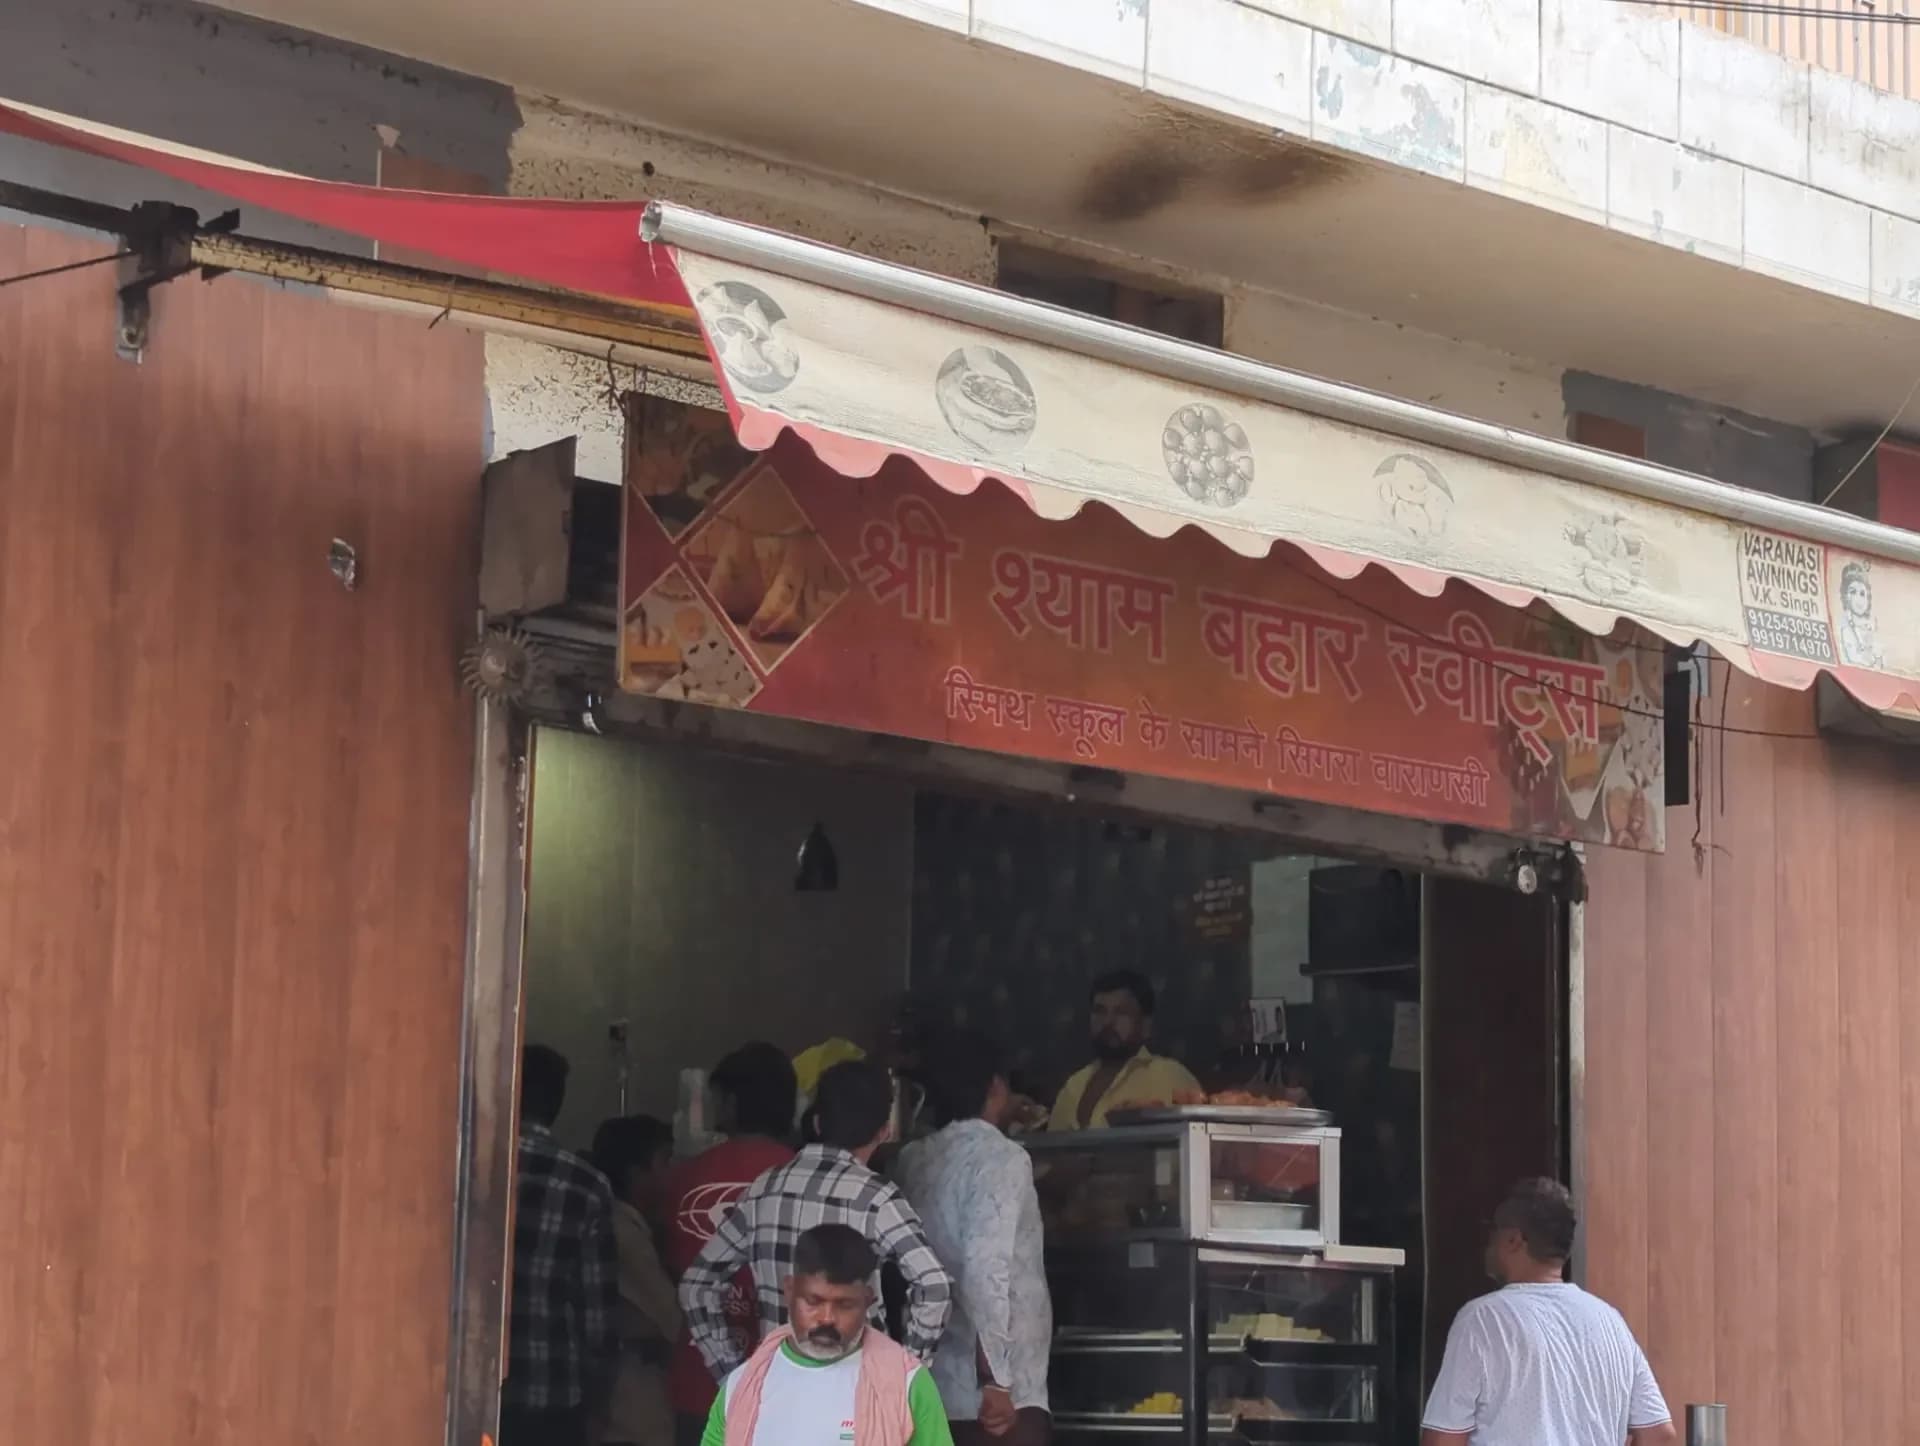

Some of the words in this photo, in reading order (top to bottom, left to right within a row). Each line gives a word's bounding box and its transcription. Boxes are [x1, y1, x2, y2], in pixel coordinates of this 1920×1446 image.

[1744, 531, 1821, 572] VARANASI
[1747, 559, 1819, 597] AWNINGS
[1751, 585, 1777, 607] V.K.
[1780, 591, 1820, 617] Singh
[850, 494, 963, 625] श्री
[992, 548, 1175, 664] श्याम
[1199, 590, 1368, 699] बहार
[1386, 611, 1606, 767] स्वीट्स
[1748, 609, 1828, 641] 9125430955
[1751, 628, 1831, 658] 9919714970
[943, 665, 1034, 730] स्मिथ
[1046, 696, 1128, 758] स्कूल
[1137, 700, 1169, 748] के
[1179, 717, 1268, 768] सामने
[1276, 724, 1361, 785] सिगरा
[1370, 754, 1490, 807] वाराणसी
